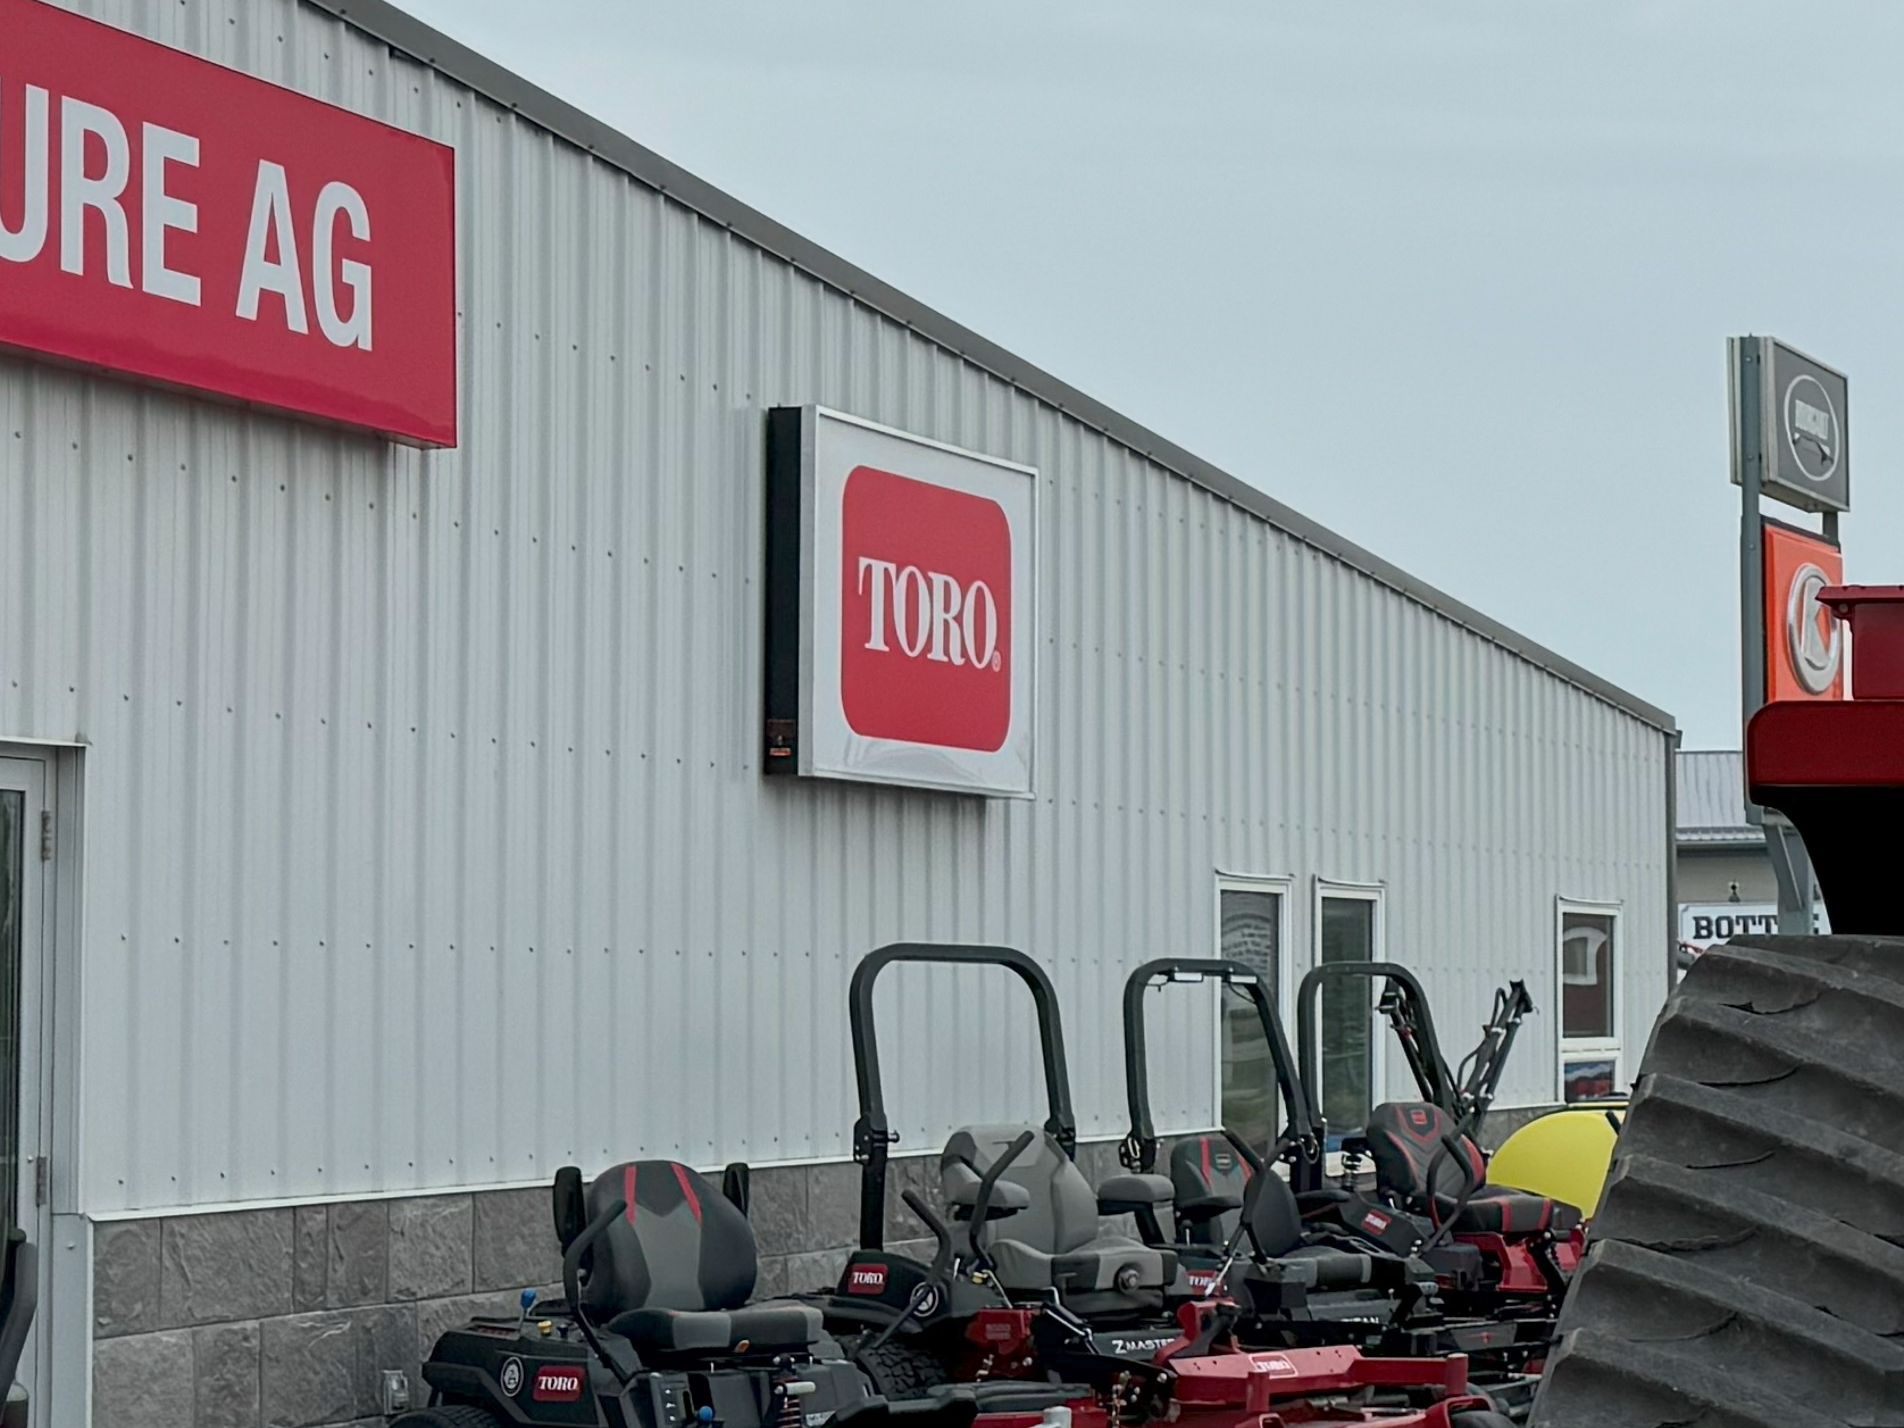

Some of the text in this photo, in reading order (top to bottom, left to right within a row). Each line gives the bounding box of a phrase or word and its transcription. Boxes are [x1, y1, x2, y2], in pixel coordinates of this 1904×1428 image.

[235, 158, 373, 352] AG
[858, 556, 998, 669] TORO
[538, 1375, 580, 1391] TORO
